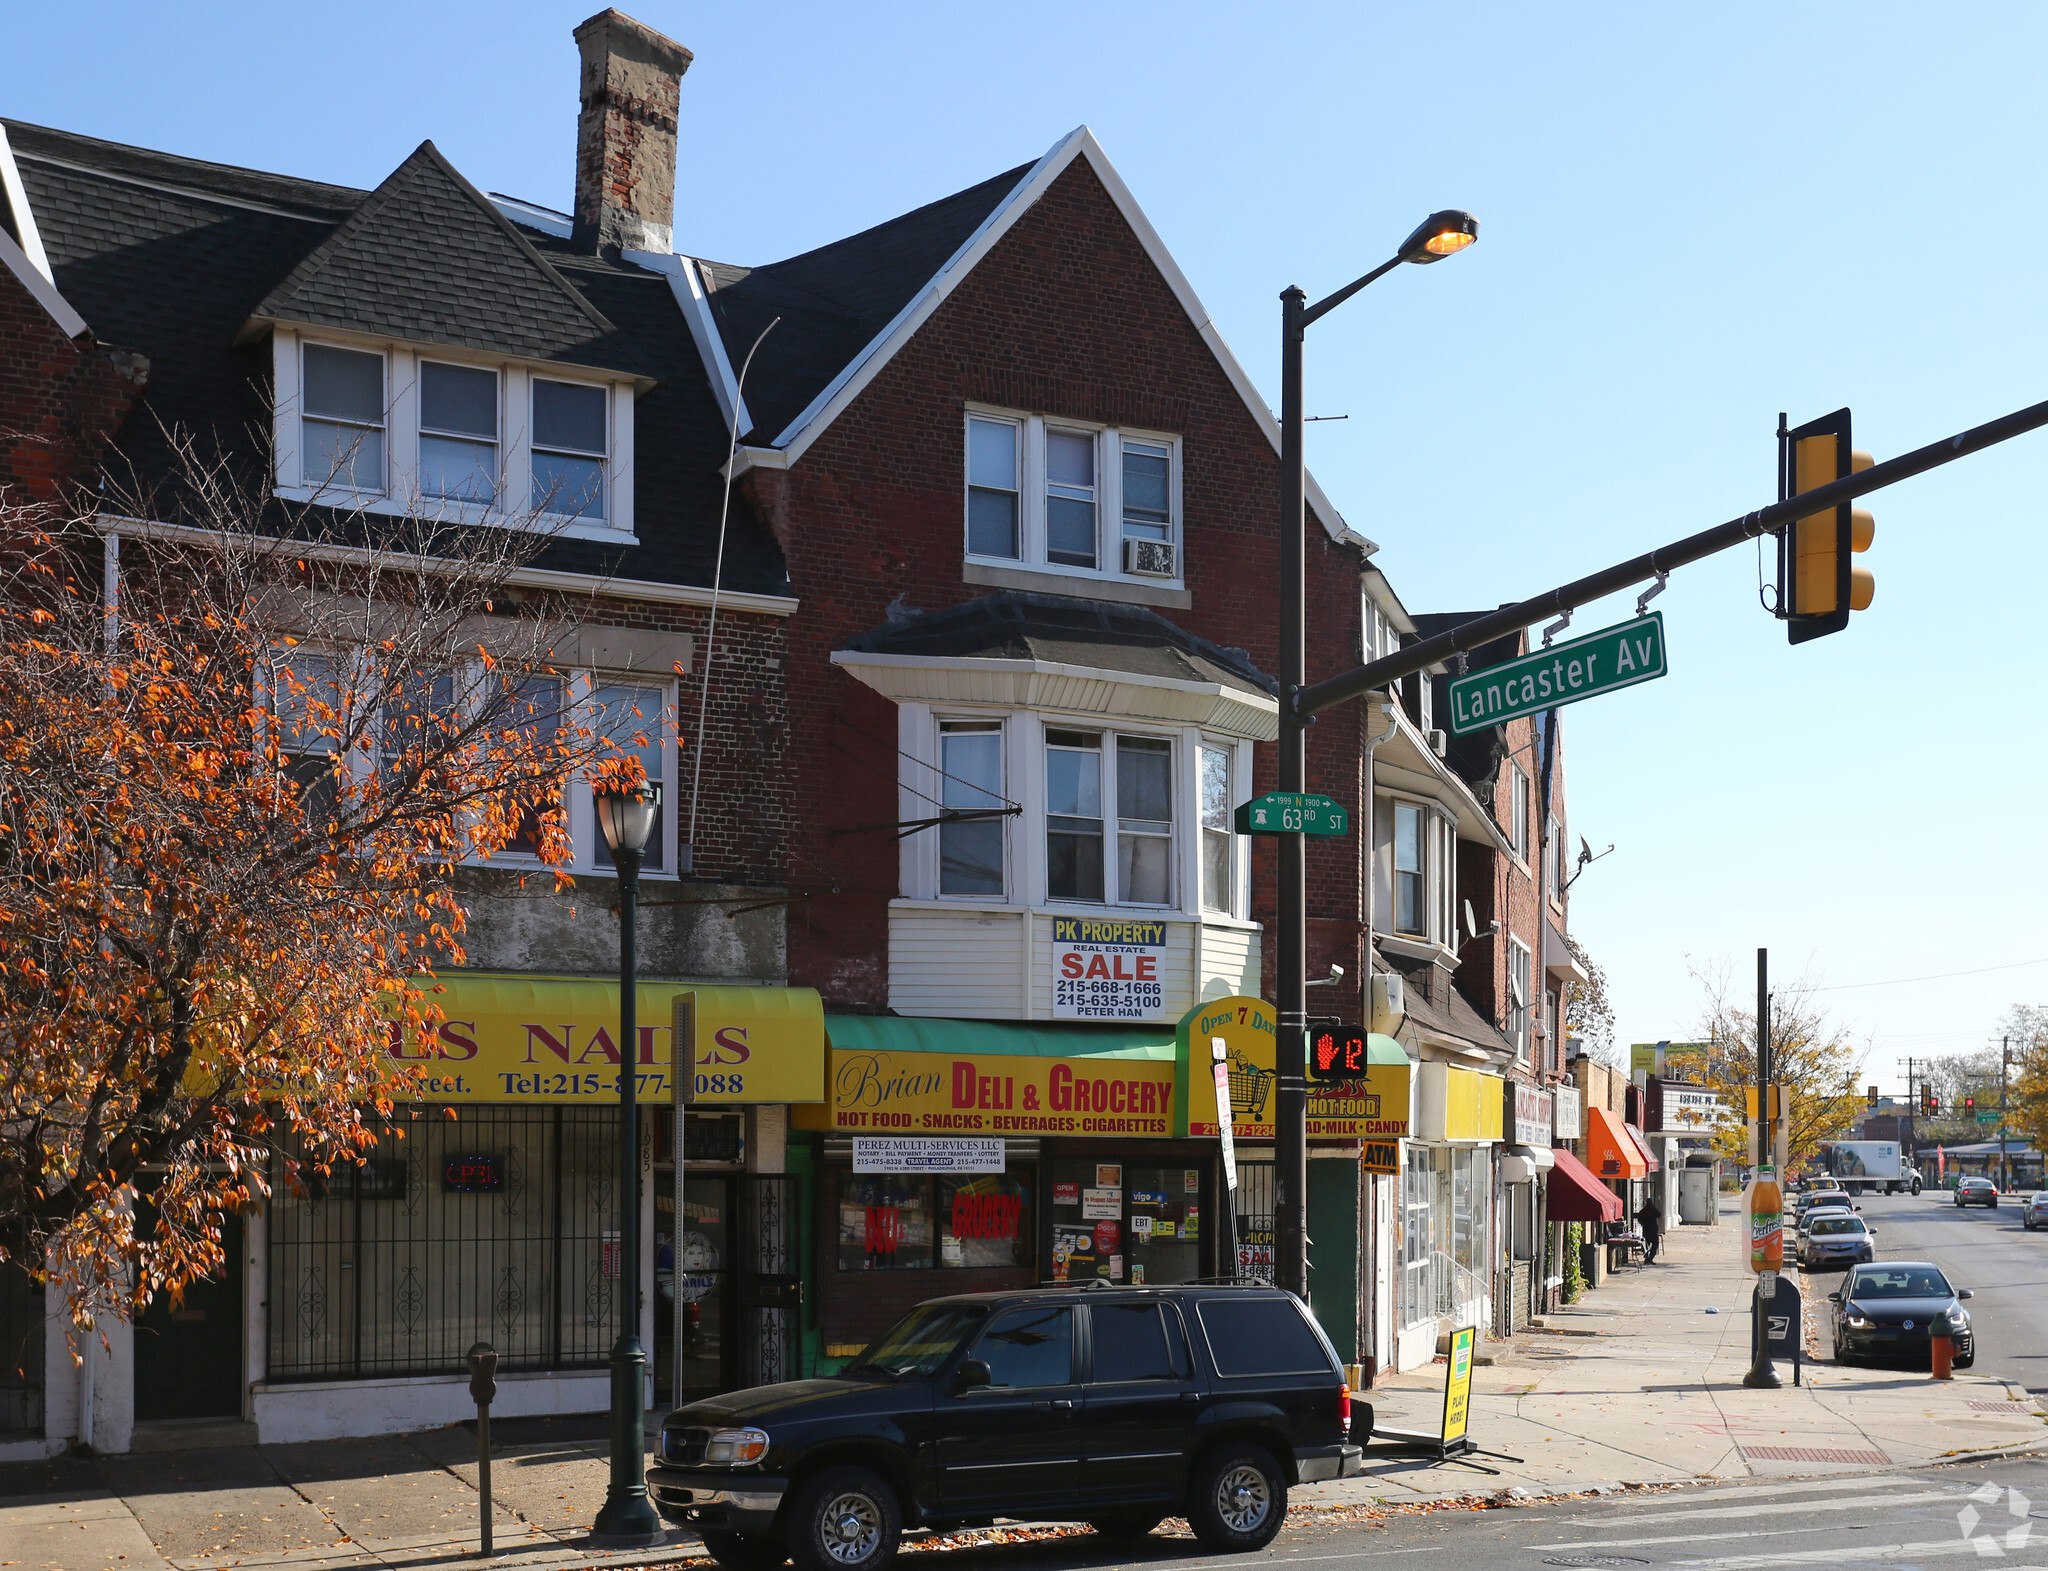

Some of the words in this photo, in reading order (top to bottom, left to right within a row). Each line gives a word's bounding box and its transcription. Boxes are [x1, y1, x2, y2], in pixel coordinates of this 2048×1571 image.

[1456, 653, 1597, 722] Lancaster
[1616, 636, 1652, 675] Av
[1277, 796, 1292, 805] 1999
[1295, 796, 1302, 807] N
[1305, 798, 1320, 807] 1900
[1329, 815, 1342, 829] ST
[1056, 920, 1077, 940] PK
[1081, 922, 1163, 944] PROPERTY
[1073, 944, 1102, 952] REAL
[1105, 945, 1146, 954] ESTATE
[1061, 952, 1157, 981] SALE
[1057, 979, 1162, 995] 215-668-1666
[1057, 993, 1161, 1008] 215-635-5100
[1077, 1007, 1115, 1016] PETER
[1118, 1008, 1142, 1017] HAN
[1201, 1011, 1233, 1035] OPEN
[1238, 1006, 1248, 1026] 7
[1345, 1038, 1363, 1071] 12
[836, 1052, 945, 1109] Brian
[951, 1061, 1014, 1110] DELI
[1023, 1084, 1041, 1111] &
[1048, 1063, 1173, 1115] GROCERY
[1308, 1099, 1335, 1115] HOT
[1339, 1099, 1376, 1116] FOOD
[837, 1111, 869, 1127] HOT
[872, 1112, 912, 1128] FOOD
[922, 1113, 983, 1129] SNACKS
[992, 1115, 1075, 1132] BEVERAGES
[1082, 1117, 1166, 1133] CIGARETTES
[1326, 1121, 1357, 1134] MILK
[1365, 1120, 1408, 1134] CANDY
[857, 1140, 892, 1150] PEREZ
[893, 1140, 979, 1151] MULTI-SERVICES
[981, 1141, 1000, 1150] LLC
[1364, 1143, 1397, 1167] ATM
[1133, 1191, 1151, 1202] vigo
[952, 1191, 1022, 1240] GROCERY
[1135, 1217, 1149, 1227] EBT
[865, 1205, 898, 1253] DELI
[1452, 1394, 1465, 1409] PLAY
[1449, 1409, 1464, 1426] HERE!
